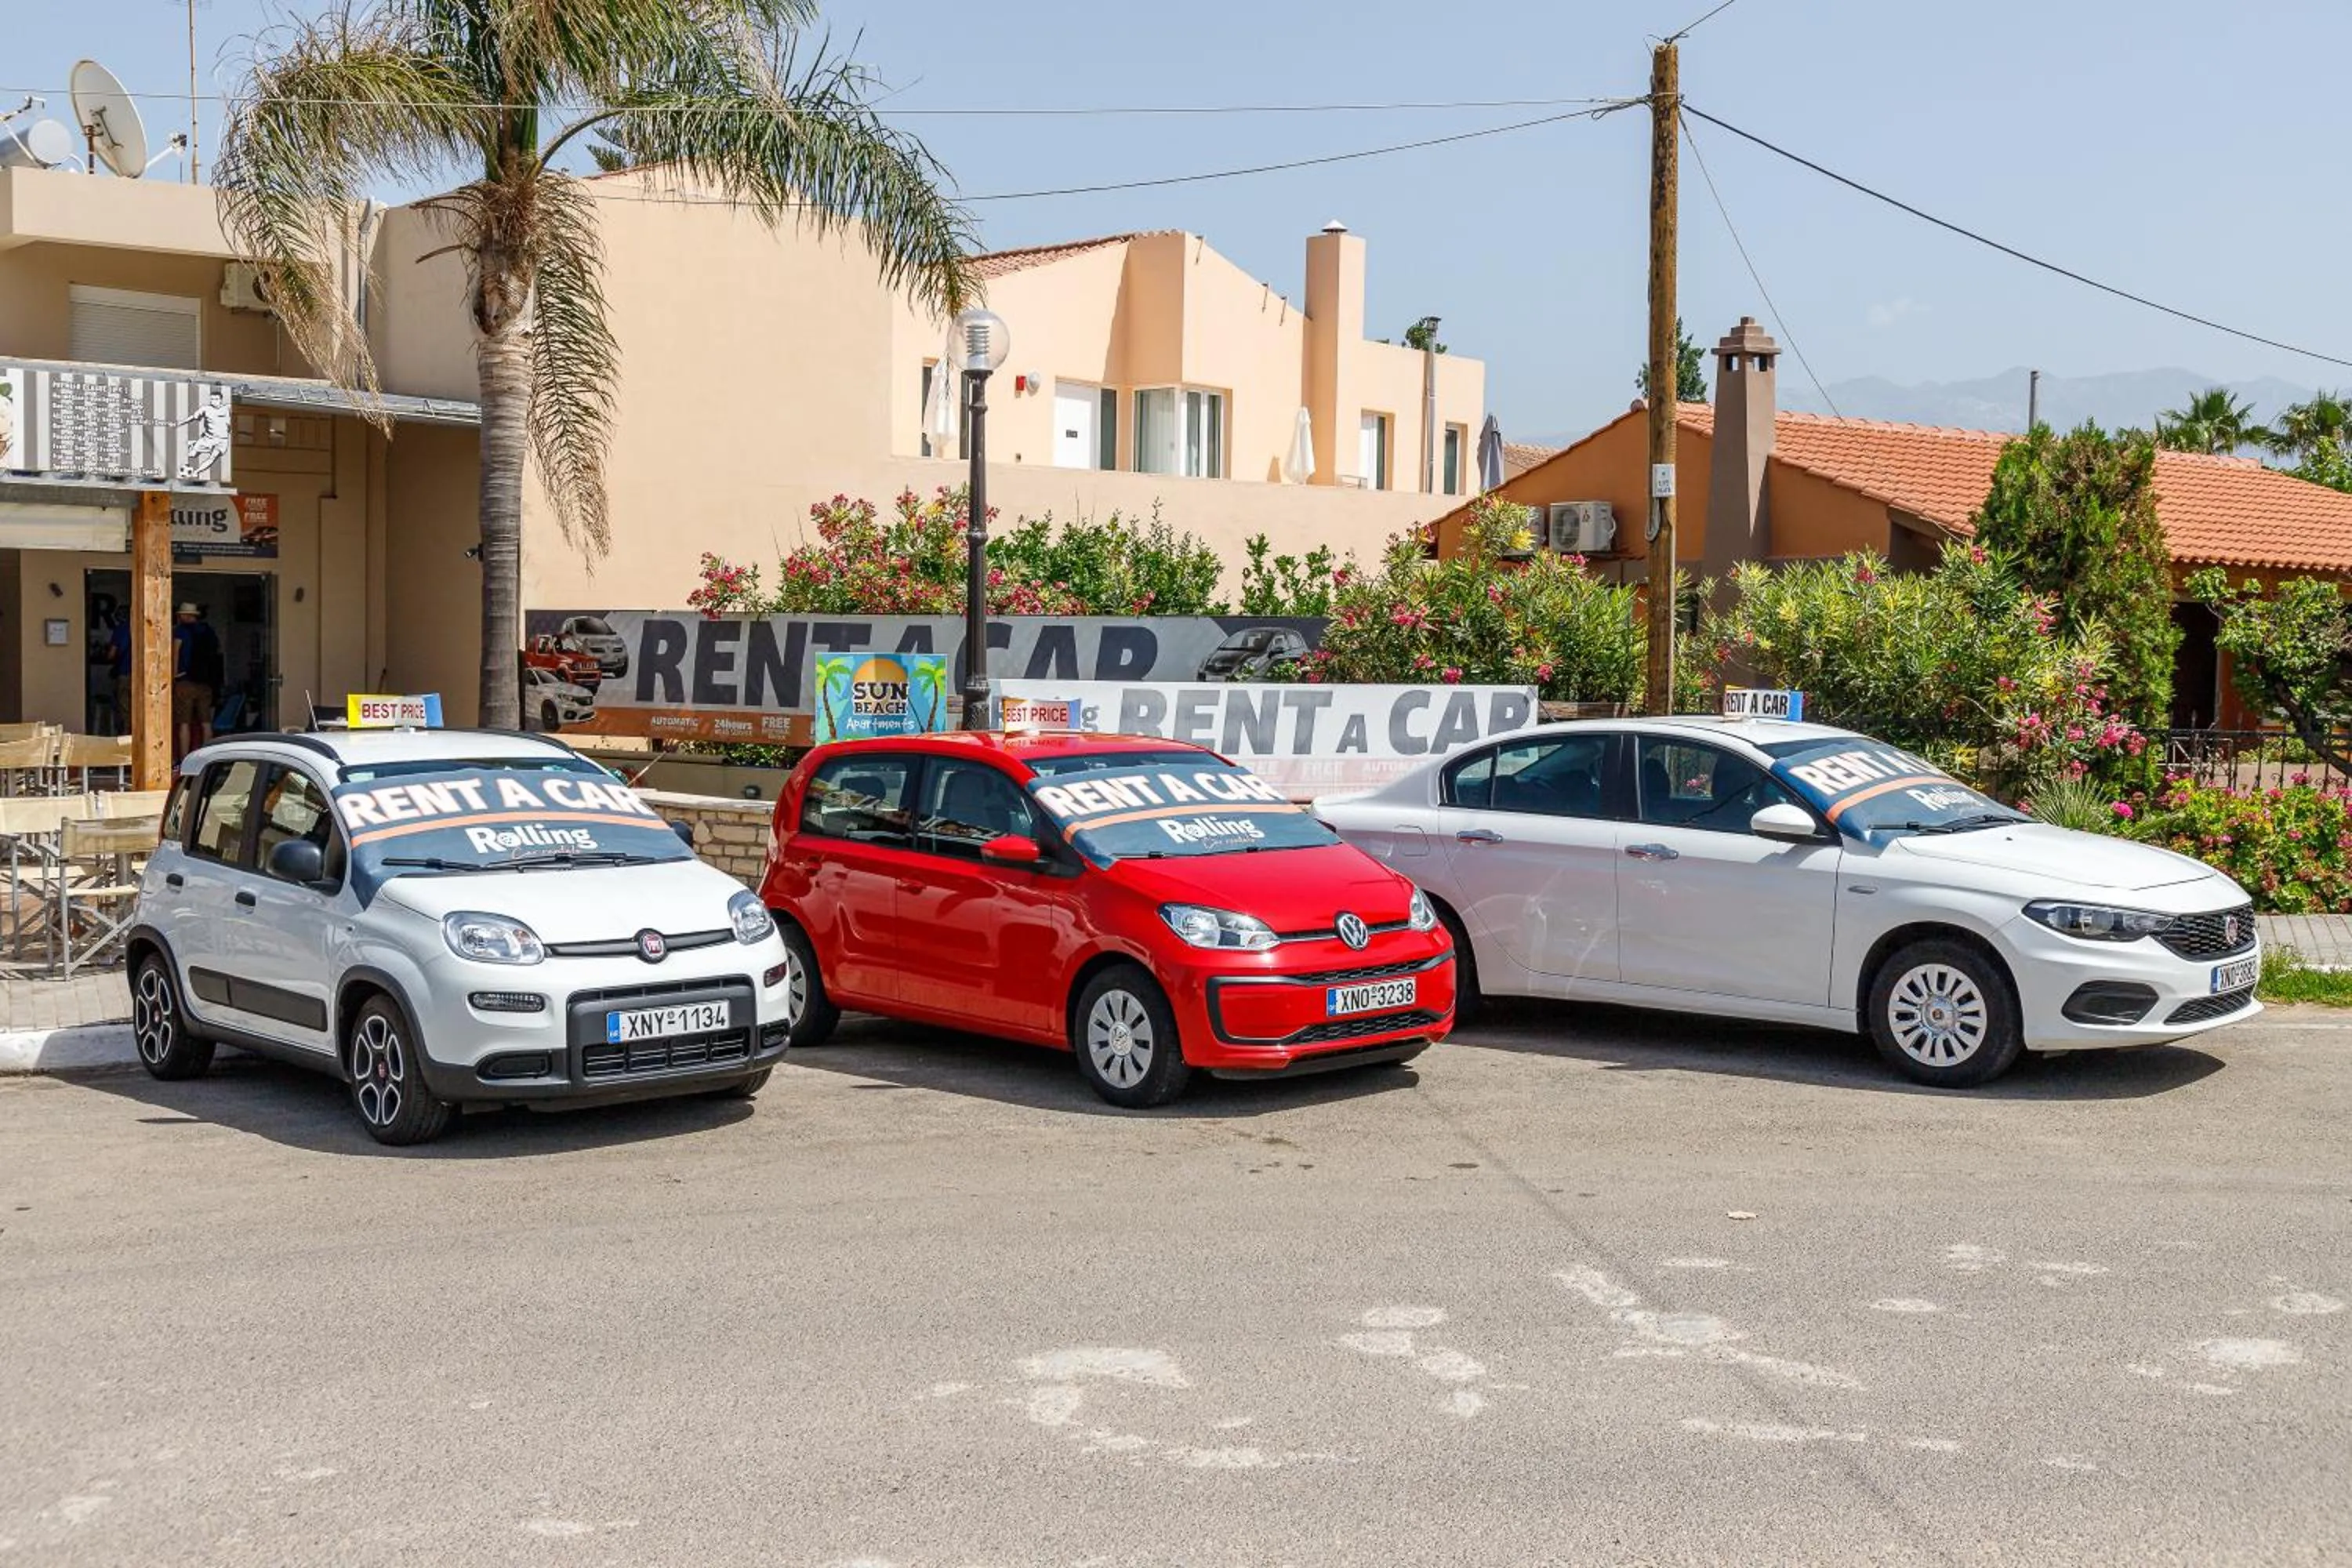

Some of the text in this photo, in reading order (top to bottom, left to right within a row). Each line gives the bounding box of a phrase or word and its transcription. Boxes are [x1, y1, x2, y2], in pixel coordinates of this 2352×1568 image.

[854, 682, 909, 700] SUN
[362, 703, 426, 720] BEST PRICE
[855, 702, 907, 714] BEACH
[1006, 707, 1067, 722] BEST PRICE
[1725, 692, 1788, 715] RENT A CAR
[762, 717, 791, 729] FREE
[846, 717, 916, 731] Apartments
[1118, 688, 1332, 755] RENT
[1336, 714, 1369, 753] A
[1788, 750, 1899, 796] RENT
[337, 778, 654, 829] RENT A CAR
[1034, 775, 1165, 817] RENT
[1158, 774, 1209, 803] A
[1193, 773, 1288, 801] CAR
[465, 823, 598, 854] Rolling
[1156, 815, 1265, 844] Rolling
